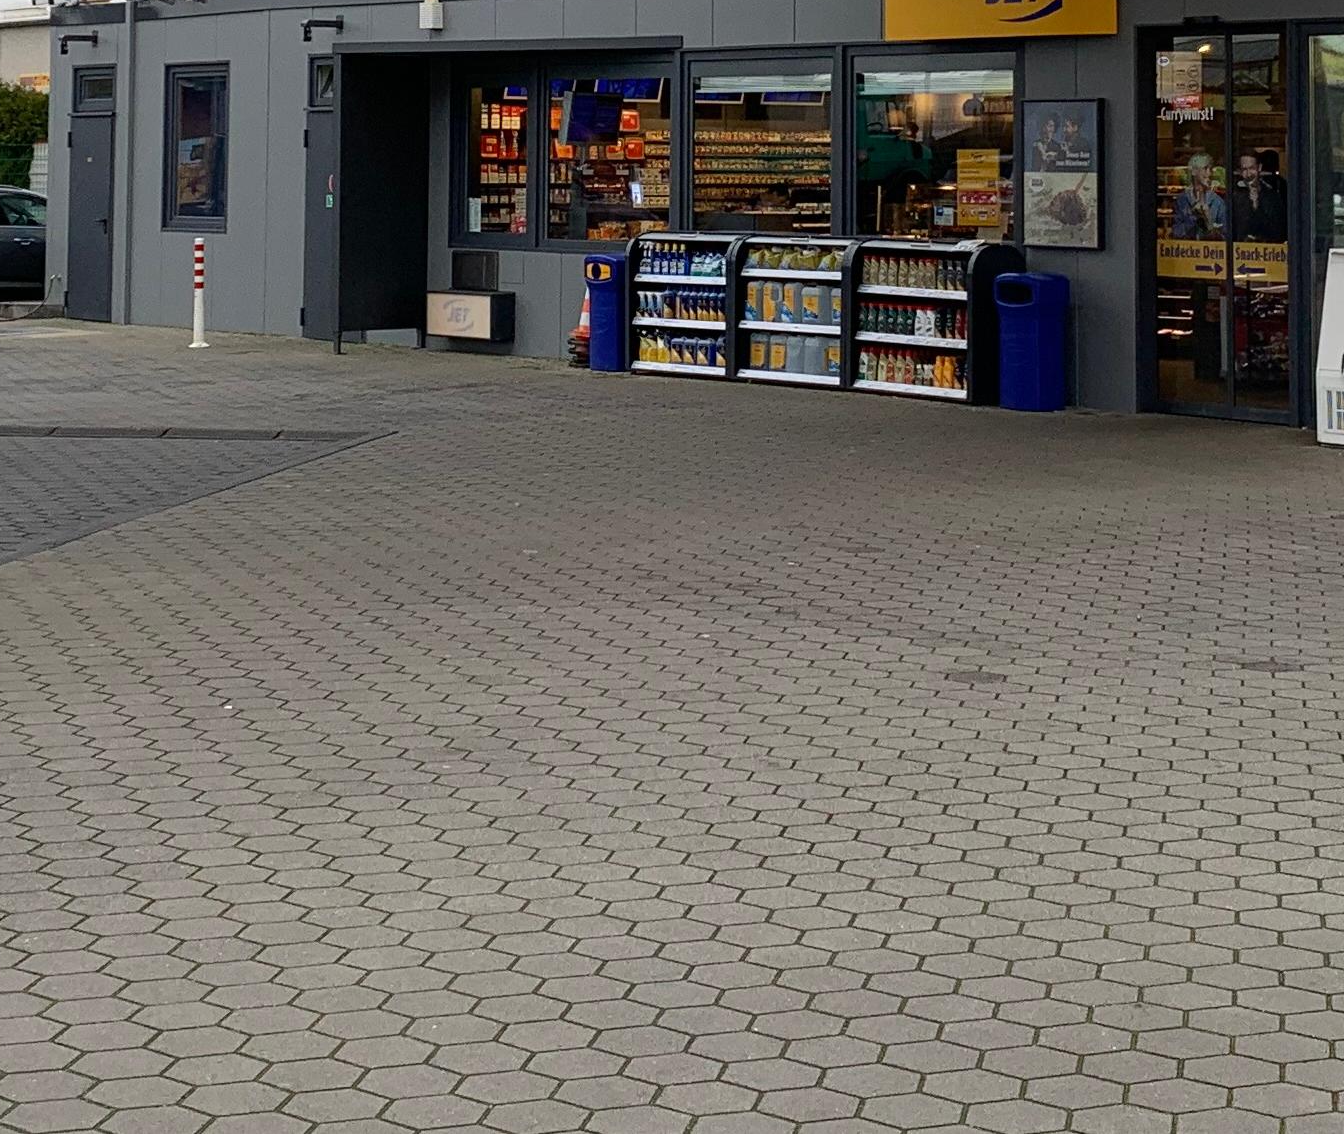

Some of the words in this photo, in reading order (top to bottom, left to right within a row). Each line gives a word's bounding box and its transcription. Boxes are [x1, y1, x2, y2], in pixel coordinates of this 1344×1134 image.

[1160, 106, 1214, 125] Currywurst!
[1160, 243, 1201, 258] Entdecke
[1203, 245, 1225, 260] Dein
[447, 307, 471, 324] JET
